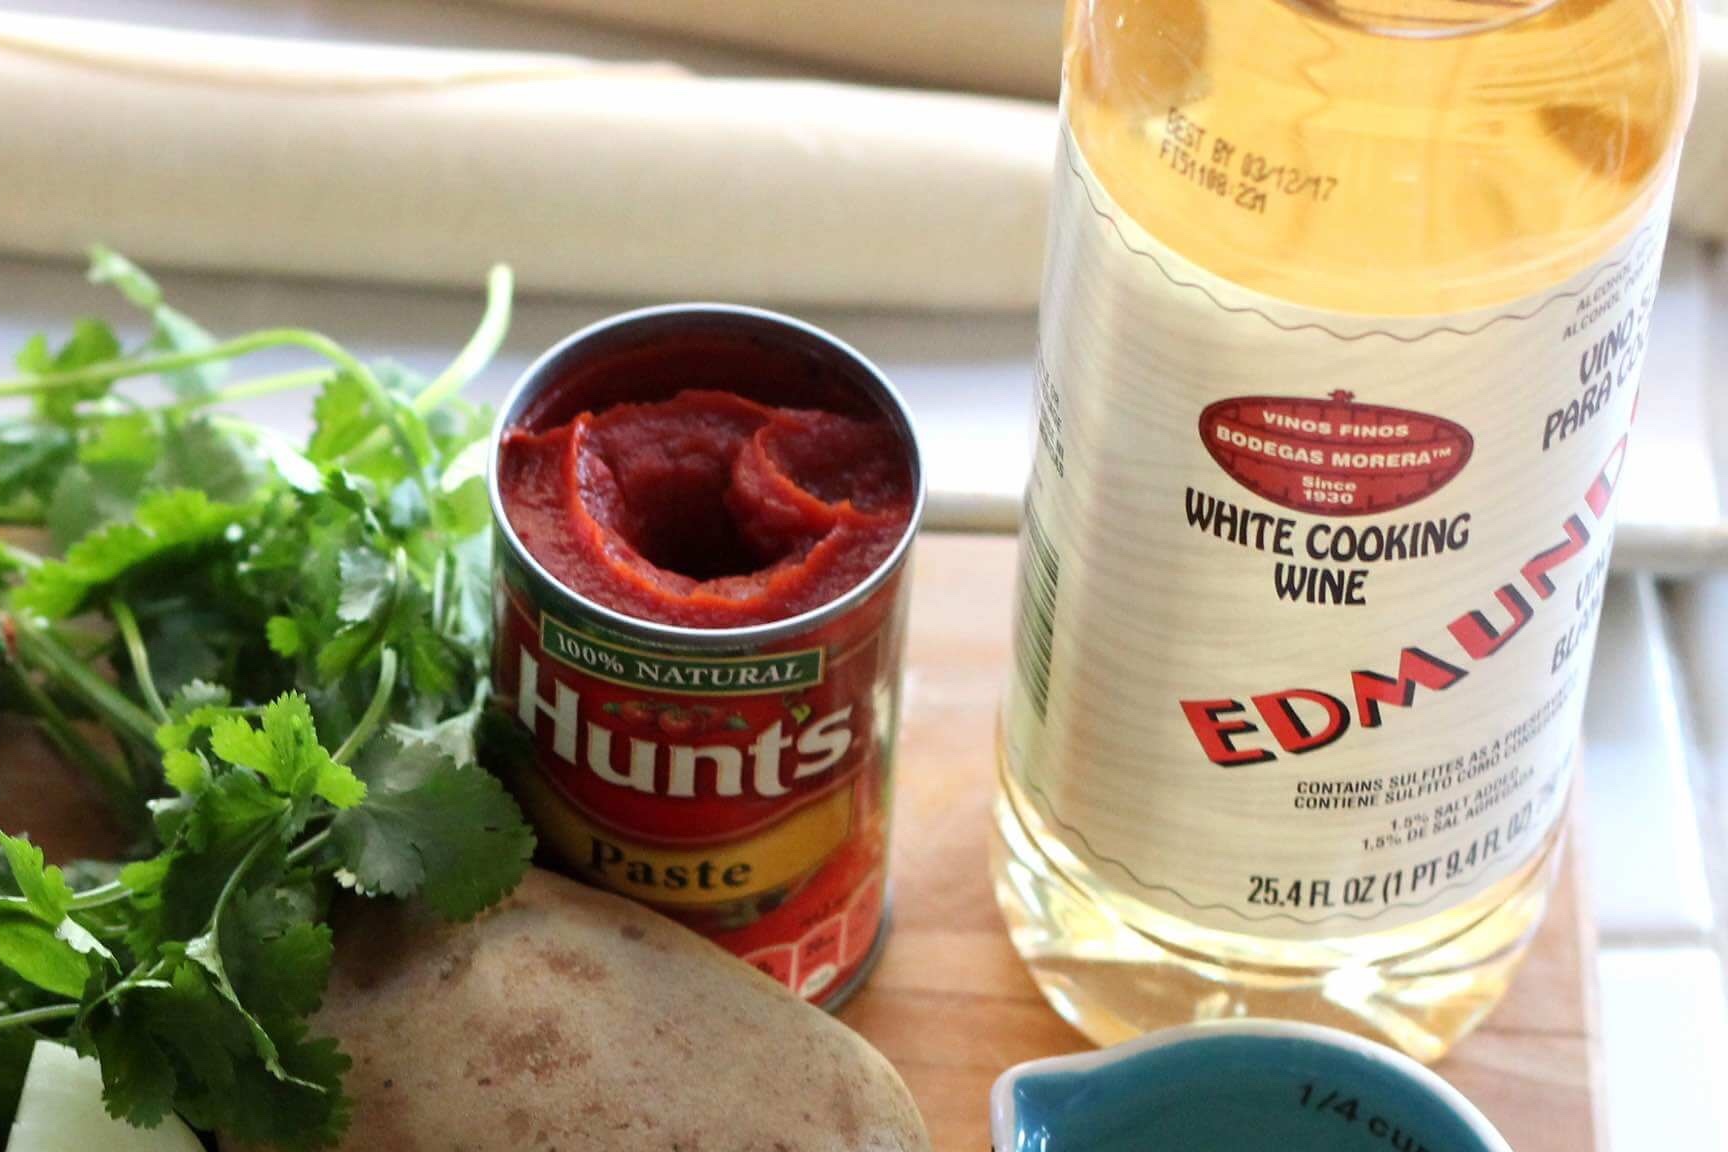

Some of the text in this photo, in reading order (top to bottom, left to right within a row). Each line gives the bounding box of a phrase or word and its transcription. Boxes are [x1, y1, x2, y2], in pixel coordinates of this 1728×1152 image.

[1211, 137, 1235, 168] BY
[1262, 410, 1410, 438] VINOS FINOS
[1542, 371, 1613, 452] PARA
[1216, 424, 1324, 465] BODEGAS
[1302, 475, 1357, 492] Since
[1303, 489, 1355, 505] 1930
[1185, 486, 1472, 563] WHITE COOKING
[1180, 387, 1639, 768] EDMUND
[1274, 562, 1370, 605] WINE
[555, 631, 804, 688] 100% NATURAL
[1294, 795, 1378, 810] CONTIENE
[1384, 776, 1453, 806] SULFITO
[1297, 780, 1383, 796] CONTAINS
[1389, 759, 1465, 792] SULFITES
[1407, 826, 1427, 843] DE
[589, 838, 754, 890] Paste
[1247, 875, 1303, 908] 25.4
[1308, 879, 1336, 909] FL
[1343, 872, 1379, 905] OZ
[1410, 858, 1444, 898] PT
[1297, 1081, 1360, 1123] 1/4
